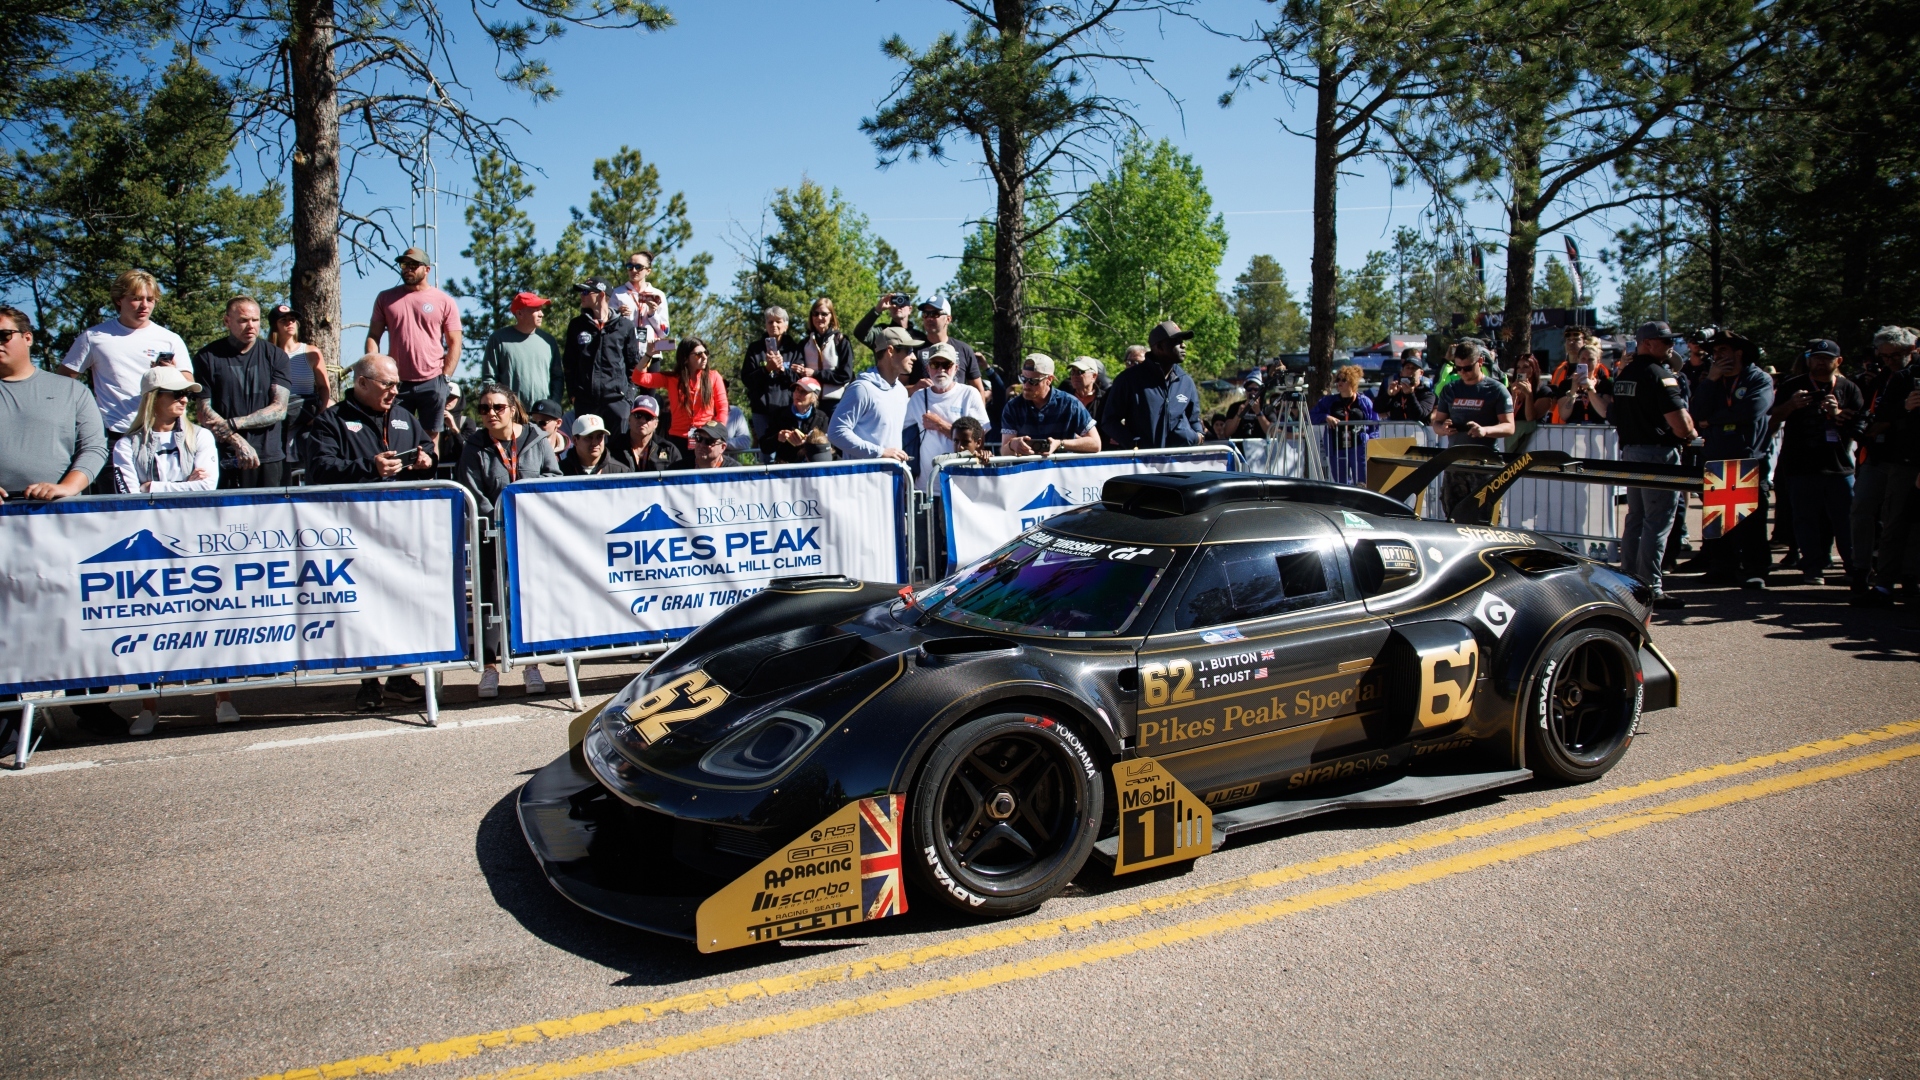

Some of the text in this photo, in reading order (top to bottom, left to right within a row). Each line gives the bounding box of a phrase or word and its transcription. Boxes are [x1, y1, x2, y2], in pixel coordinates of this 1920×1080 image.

[1487, 453, 1533, 493] YOKOHAMA
[696, 499, 821, 525] BROADMOOR
[718, 497, 736, 506] THE
[197, 527, 356, 554] BROADMOOR
[226, 523, 249, 533] THE
[606, 526, 822, 567] PIKES PEAK
[80, 557, 357, 602] PIKES PEAK
[608, 554, 822, 584] INTERNATIONAL HILL CLIMB
[82, 590, 358, 621] INTERNATIONAL HILL CLIMB
[661, 592, 705, 612] GRAN
[708, 587, 765, 607] TURISM
[1483, 600, 1508, 627] G
[152, 630, 208, 652] GRAN
[213, 623, 297, 647] TURISMO
[1198, 651, 1259, 673] J. BUTTON
[1142, 658, 1196, 708] 62
[1200, 669, 1251, 689] T. FOUST
[1418, 638, 1480, 729] 62
[622, 669, 731, 746] 62
[1540, 659, 1557, 730] ADVAN
[1137, 674, 1384, 749] Pikes Peak Special
[1627, 683, 1644, 737] YOKOHAMA
[1055, 721, 1096, 779] YOKOHAMA
[1287, 754, 1389, 790] stratasys
[1122, 781, 1175, 809] Mobil
[1206, 784, 1258, 805] JUBU
[824, 823, 856, 838] R53
[1138, 809, 1155, 858] 1
[791, 842, 850, 860] aria
[923, 844, 987, 907] ADVAN
[777, 894, 844, 911] PERFORMANCE
[779, 881, 850, 907] scarbo
[775, 901, 842, 921] RACING SEATS
